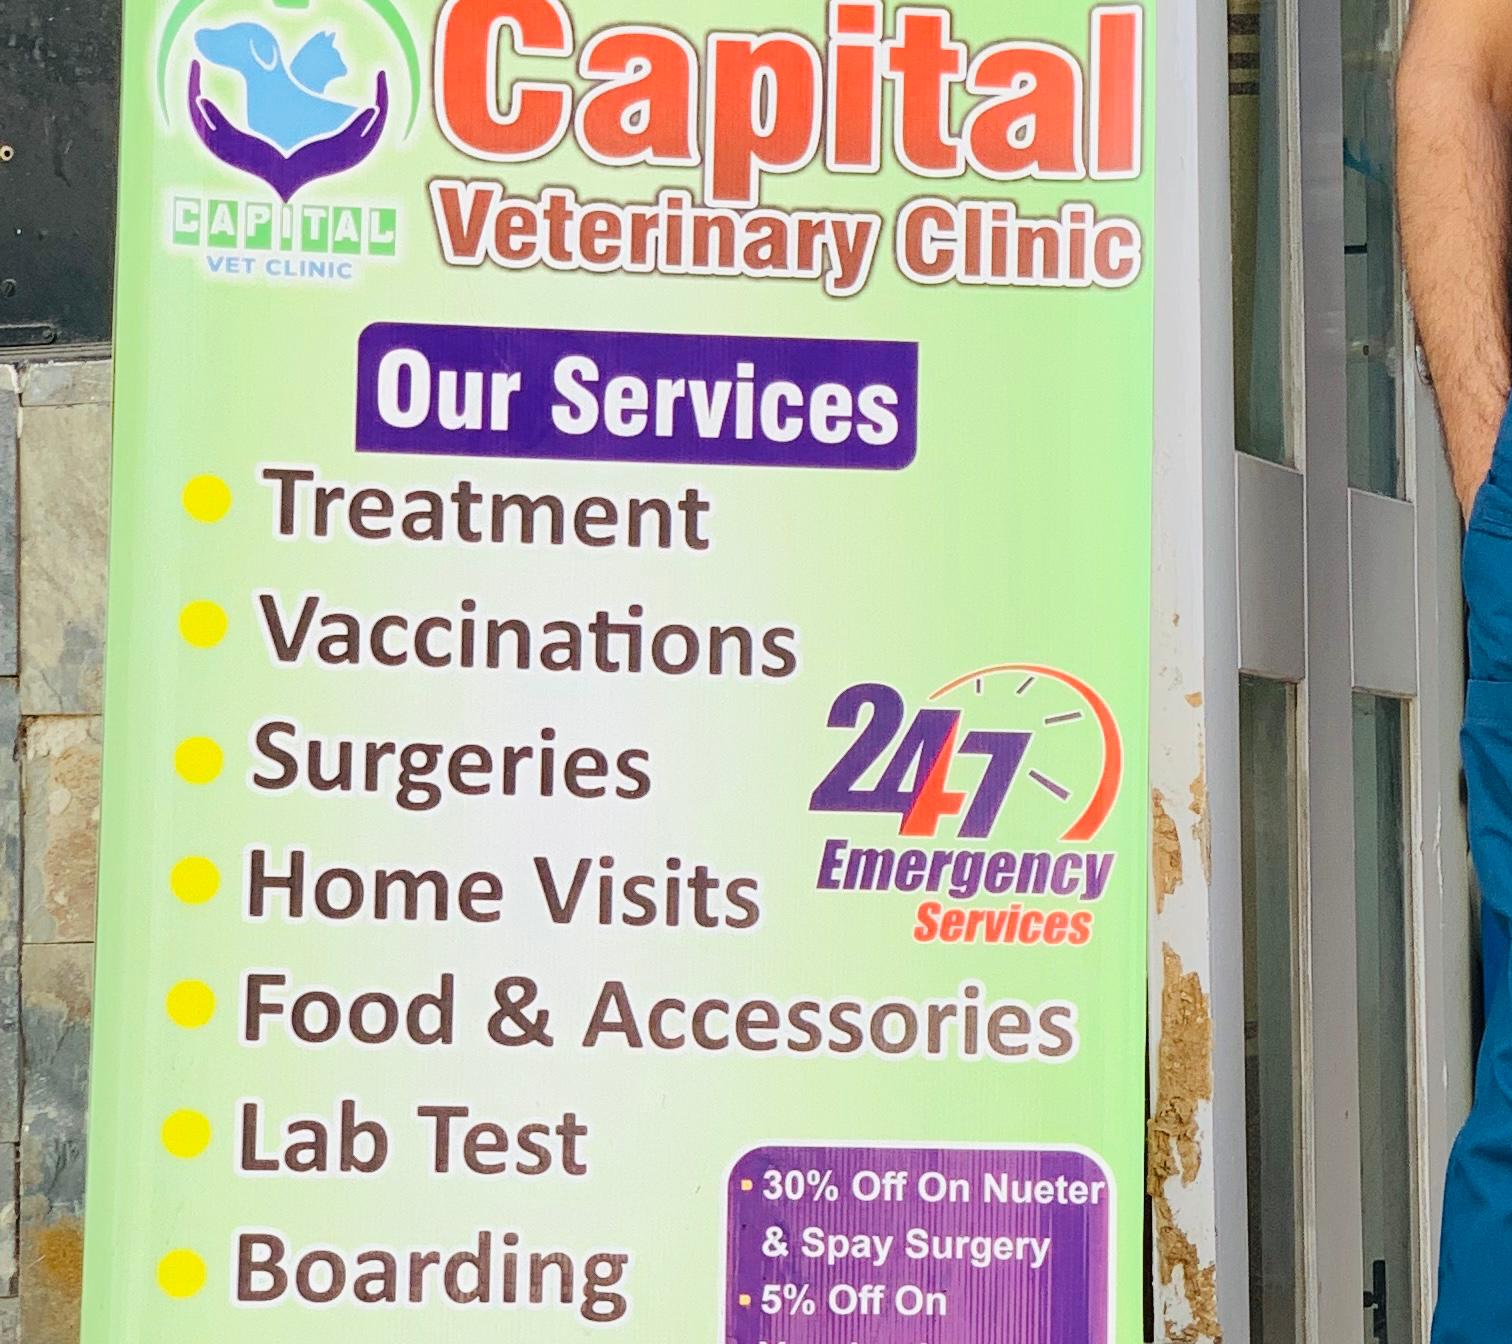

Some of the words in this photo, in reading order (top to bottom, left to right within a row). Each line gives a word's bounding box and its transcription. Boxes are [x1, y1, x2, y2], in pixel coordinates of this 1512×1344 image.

[173, 197, 396, 256] CAPITAL
[438, 187, 870, 290] Veterinary
[905, 203, 1136, 284] Clinic
[207, 256, 255, 273] VET
[266, 259, 352, 278] CLINIC
[377, 349, 521, 433] Our
[551, 356, 899, 444] Services
[262, 468, 709, 550] Treatment
[259, 595, 796, 678] Vaccinations
[254, 721, 650, 810] Surgeries
[249, 849, 502, 921] Home
[534, 855, 760, 927] Visits
[816, 839, 1115, 901] Emergency
[913, 902, 1092, 944] Services
[245, 973, 453, 1045] Food
[488, 977, 554, 1046] &
[583, 980, 1074, 1058] Accessories
[242, 1098, 388, 1173] Lab
[417, 1105, 587, 1174] Test
[763, 1169, 839, 1202] 30%
[852, 1171, 907, 1201] Off
[918, 1172, 969, 1202] On
[984, 1173, 1104, 1205] Nueter
[237, 1230, 628, 1323] Boarding
[762, 1226, 788, 1258] &
[801, 1227, 893, 1267] Spay
[905, 1228, 1050, 1268] Surgery
[761, 1284, 815, 1316] 5%
[828, 1284, 884, 1315] Off
[895, 1285, 946, 1315] On
